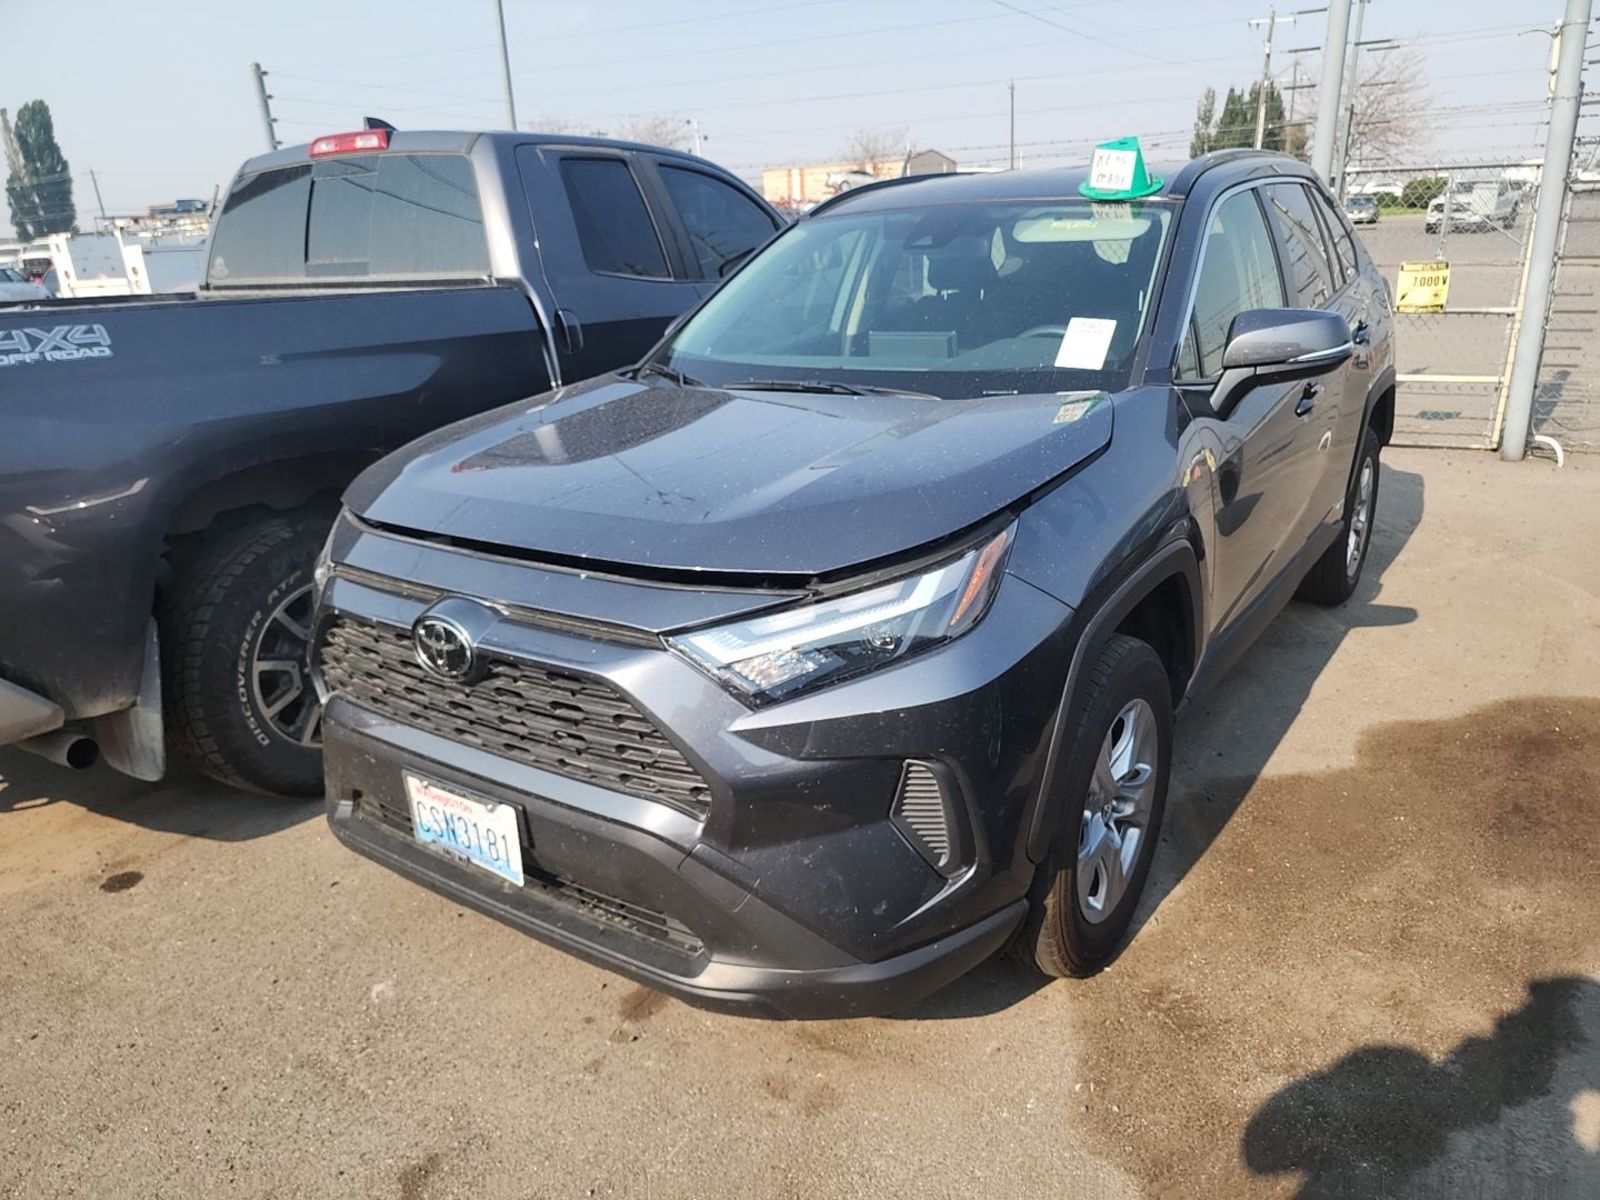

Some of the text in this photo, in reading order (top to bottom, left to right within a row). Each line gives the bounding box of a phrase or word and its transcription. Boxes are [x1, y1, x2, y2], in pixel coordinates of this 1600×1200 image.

[44, 346, 112, 361] ROAD
[238, 610, 271, 747] DISCOVERER
[416, 801, 511, 869] CSN3181
